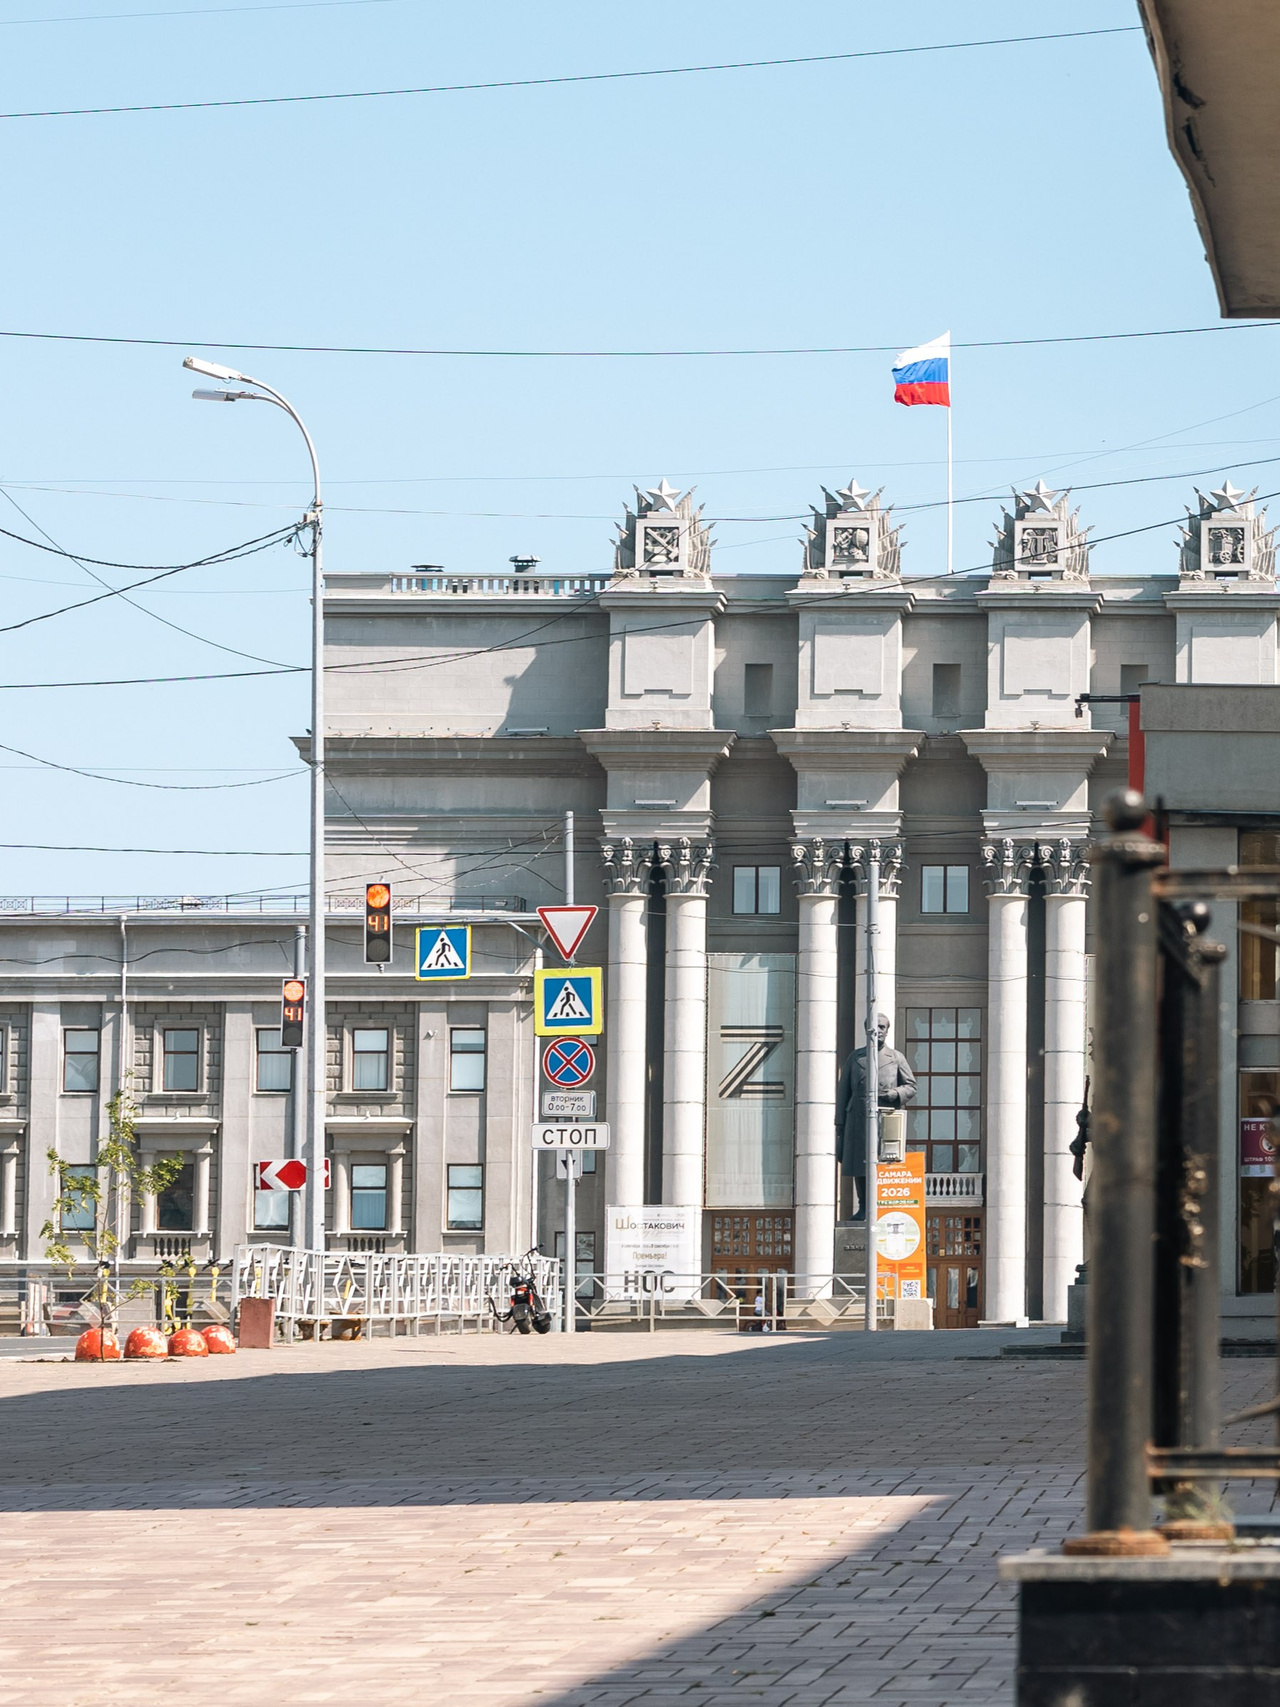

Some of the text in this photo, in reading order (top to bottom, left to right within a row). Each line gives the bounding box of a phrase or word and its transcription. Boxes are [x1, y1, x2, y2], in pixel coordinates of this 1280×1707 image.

[368, 915, 389, 932] 41
[284, 1007, 302, 1021] 41
[1243, 1123, 1257, 1131] НЕ
[542, 1128, 597, 1145] СТОП
[878, 1170, 912, 1178] САМАРА
[877, 1177, 922, 1185] ДВИЖЕНИИ
[881, 1187, 911, 1197] 2026
[624, 1270, 676, 1293] НОС
